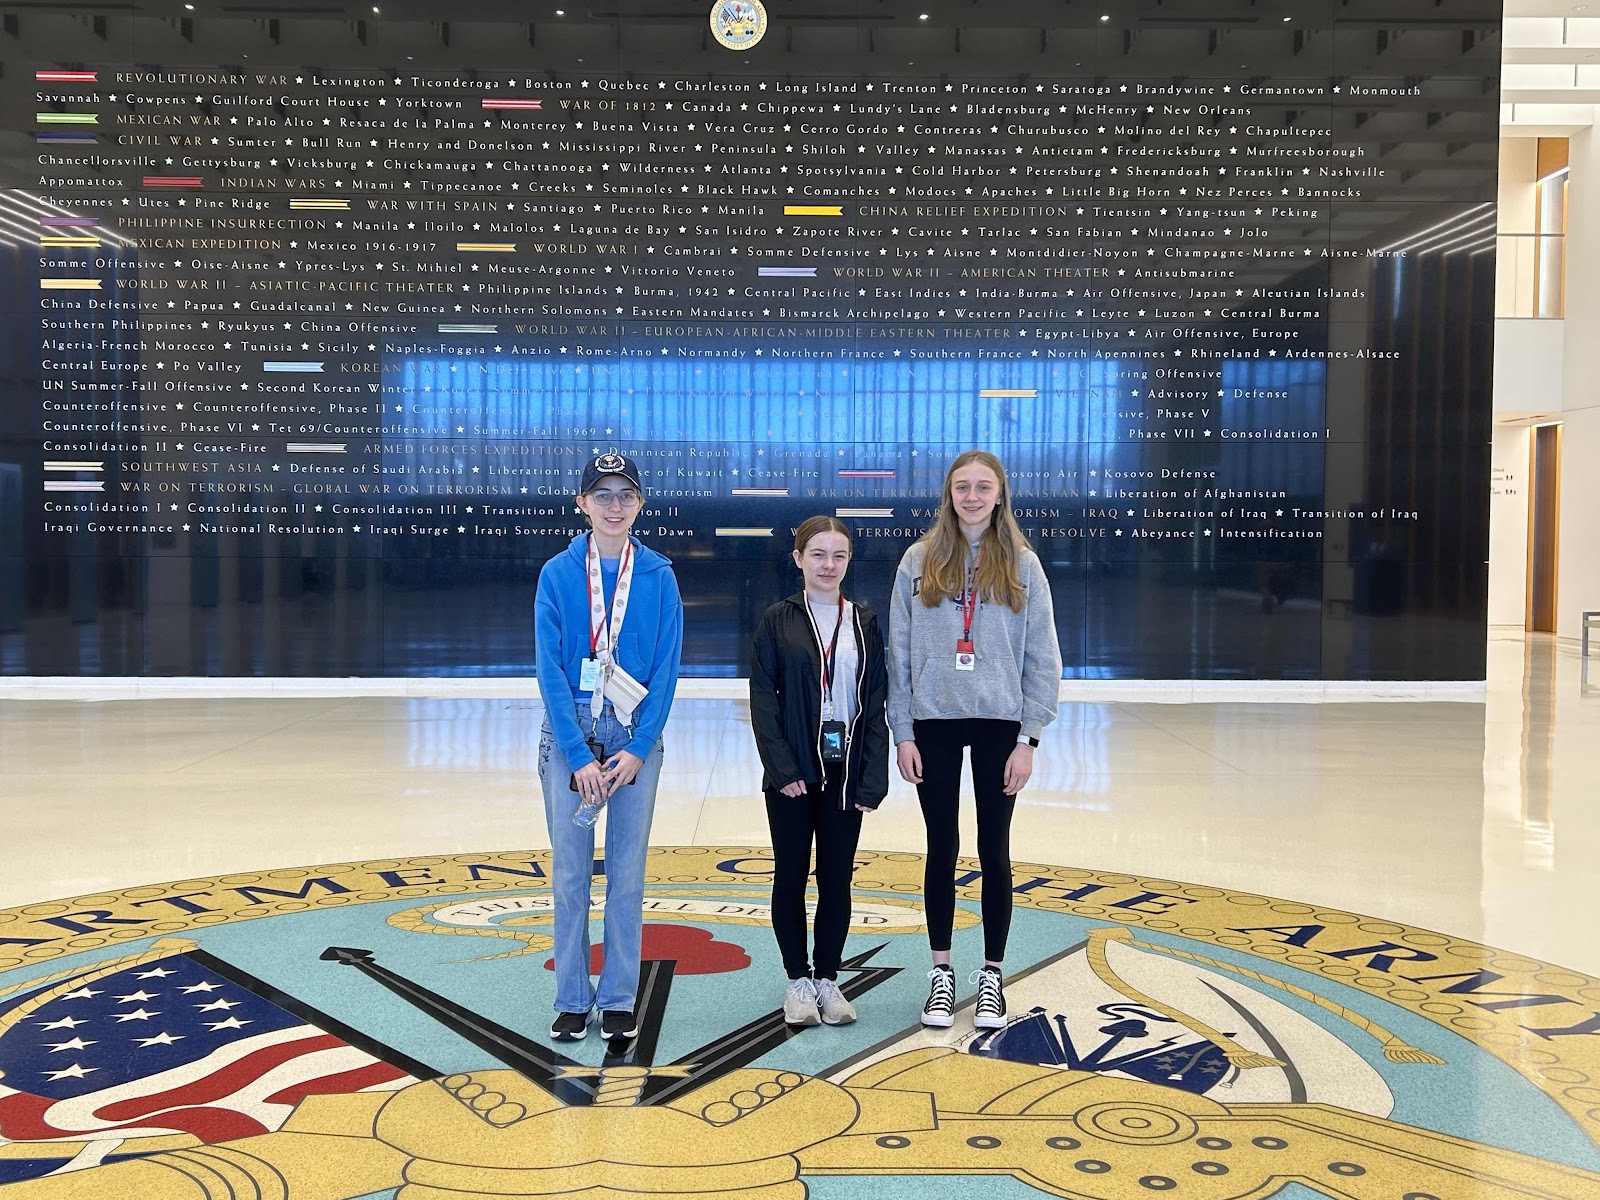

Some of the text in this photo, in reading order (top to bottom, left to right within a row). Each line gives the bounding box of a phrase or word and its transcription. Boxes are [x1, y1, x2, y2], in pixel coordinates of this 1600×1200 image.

[116, 72, 1421, 96] REVOLUTIONARY WAR Lexington Ticonderoga Boston Quebec Charleston Long Island Trenton Princeton Saratoga Brandywine Germantown Monmouth
[116, 114, 1332, 138] MEXICAN WAR Palo Alto Resaca de la Palma Monterey Buena Vista Vera Cruz Cerro Gordo Contreras Churubusco Molino del Rey Chapultepec
[37, 154, 1385, 178] Chancellorsville Gettysburg Vicksburg Chickamauga Chattanooga Wilderness Atlanta Spotsylvania Cold Harbor Petersburg Shenandoah Franklin Nashville
[117, 217, 1268, 239] PHILIPPINE INSURRECTION Manila Iloilo Malolos Laguna de Bay San Isidro Zapote River Cavite Tarlac San Fabian Mindanao Jolo
[40, 298, 1320, 321] China Defensive Papua Guadalcanal New Guinea Northern Solomons Eastern Mandates Bismarck Archipelago Western Pacific Leyte Luzon Central Burma
[41, 338, 1400, 361] Algeria-French Morocco Tunisia Sicily Naples-Foggia Anzio Rome-Arno Normandy Northern France Southern France North Apennines Rhineland Ardennes-Alsace
[42, 379, 362, 393] UN Summer-Fall Offensive Second Korean
[1147, 388, 1288, 401] Advisory Defense
[42, 420, 448, 434] Counteroffensive, Phase VI Tet 69/Counteroffensive
[1129, 428, 1167, 439] Phase
[1173, 428, 1195, 439] VII
[1220, 428, 1318, 439] Consolidation
[121, 461, 560, 476] SOUTHWEST ASIA Defense of Saudi Arabia Liberation
[656, 466, 819, 478] of Kuwait Cease-Fire
[1104, 467, 1216, 479] Kosovo Defense
[187, 502, 554, 516] Consolidation II Consolidation III Transition
[1143, 507, 1418, 521] Liberation of Iraq Transition of Iraq
[44, 521, 173, 534] Iraqi Governance
[1131, 527, 1323, 541] Abeyance Intensification
[450, 899, 550, 917] THIS
